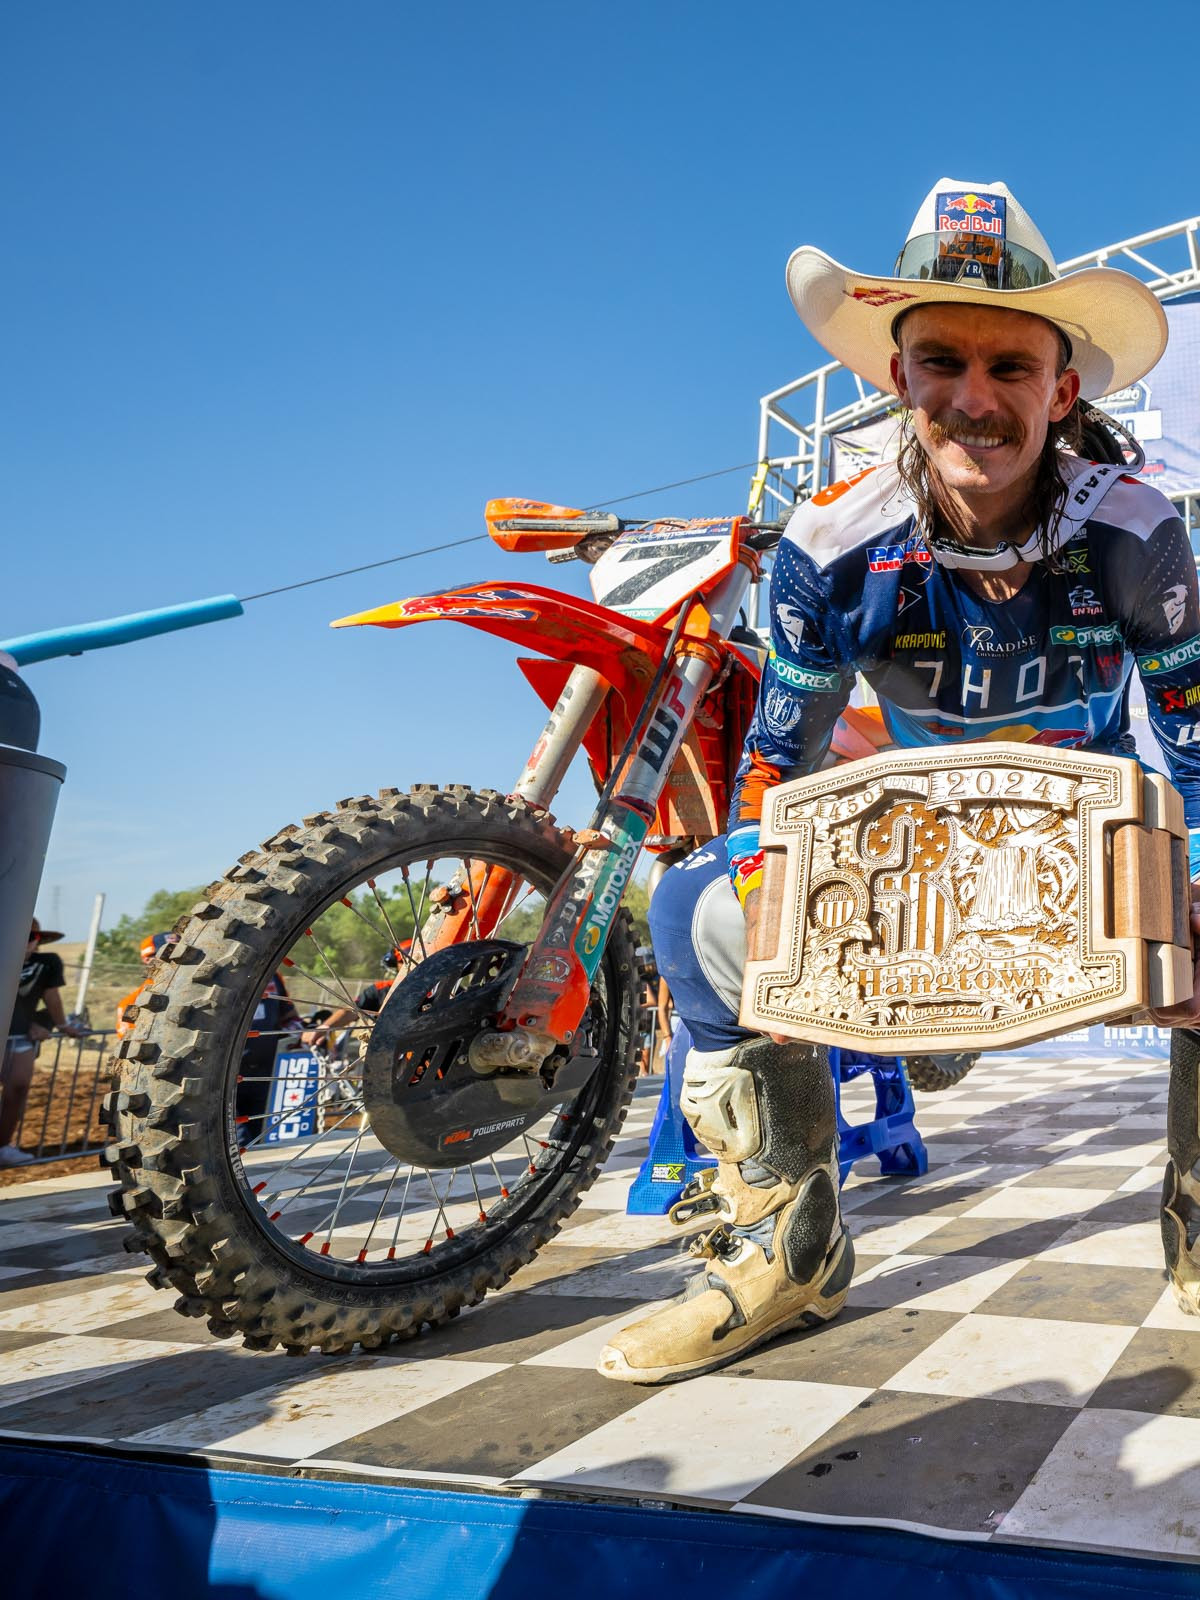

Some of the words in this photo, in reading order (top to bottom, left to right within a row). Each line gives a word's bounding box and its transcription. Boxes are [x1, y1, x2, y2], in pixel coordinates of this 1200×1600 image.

[938, 214, 970, 232] Red
[972, 215, 1002, 235] Bull
[600, 540, 722, 607] 7
[947, 770, 1052, 798] 2024
[828, 790, 876, 822] 450
[587, 838, 643, 928] MOTOREX
[824, 891, 849, 902] NORTH
[857, 963, 1053, 998] Hangtown
[473, 1116, 526, 1139] POWERPARTS
